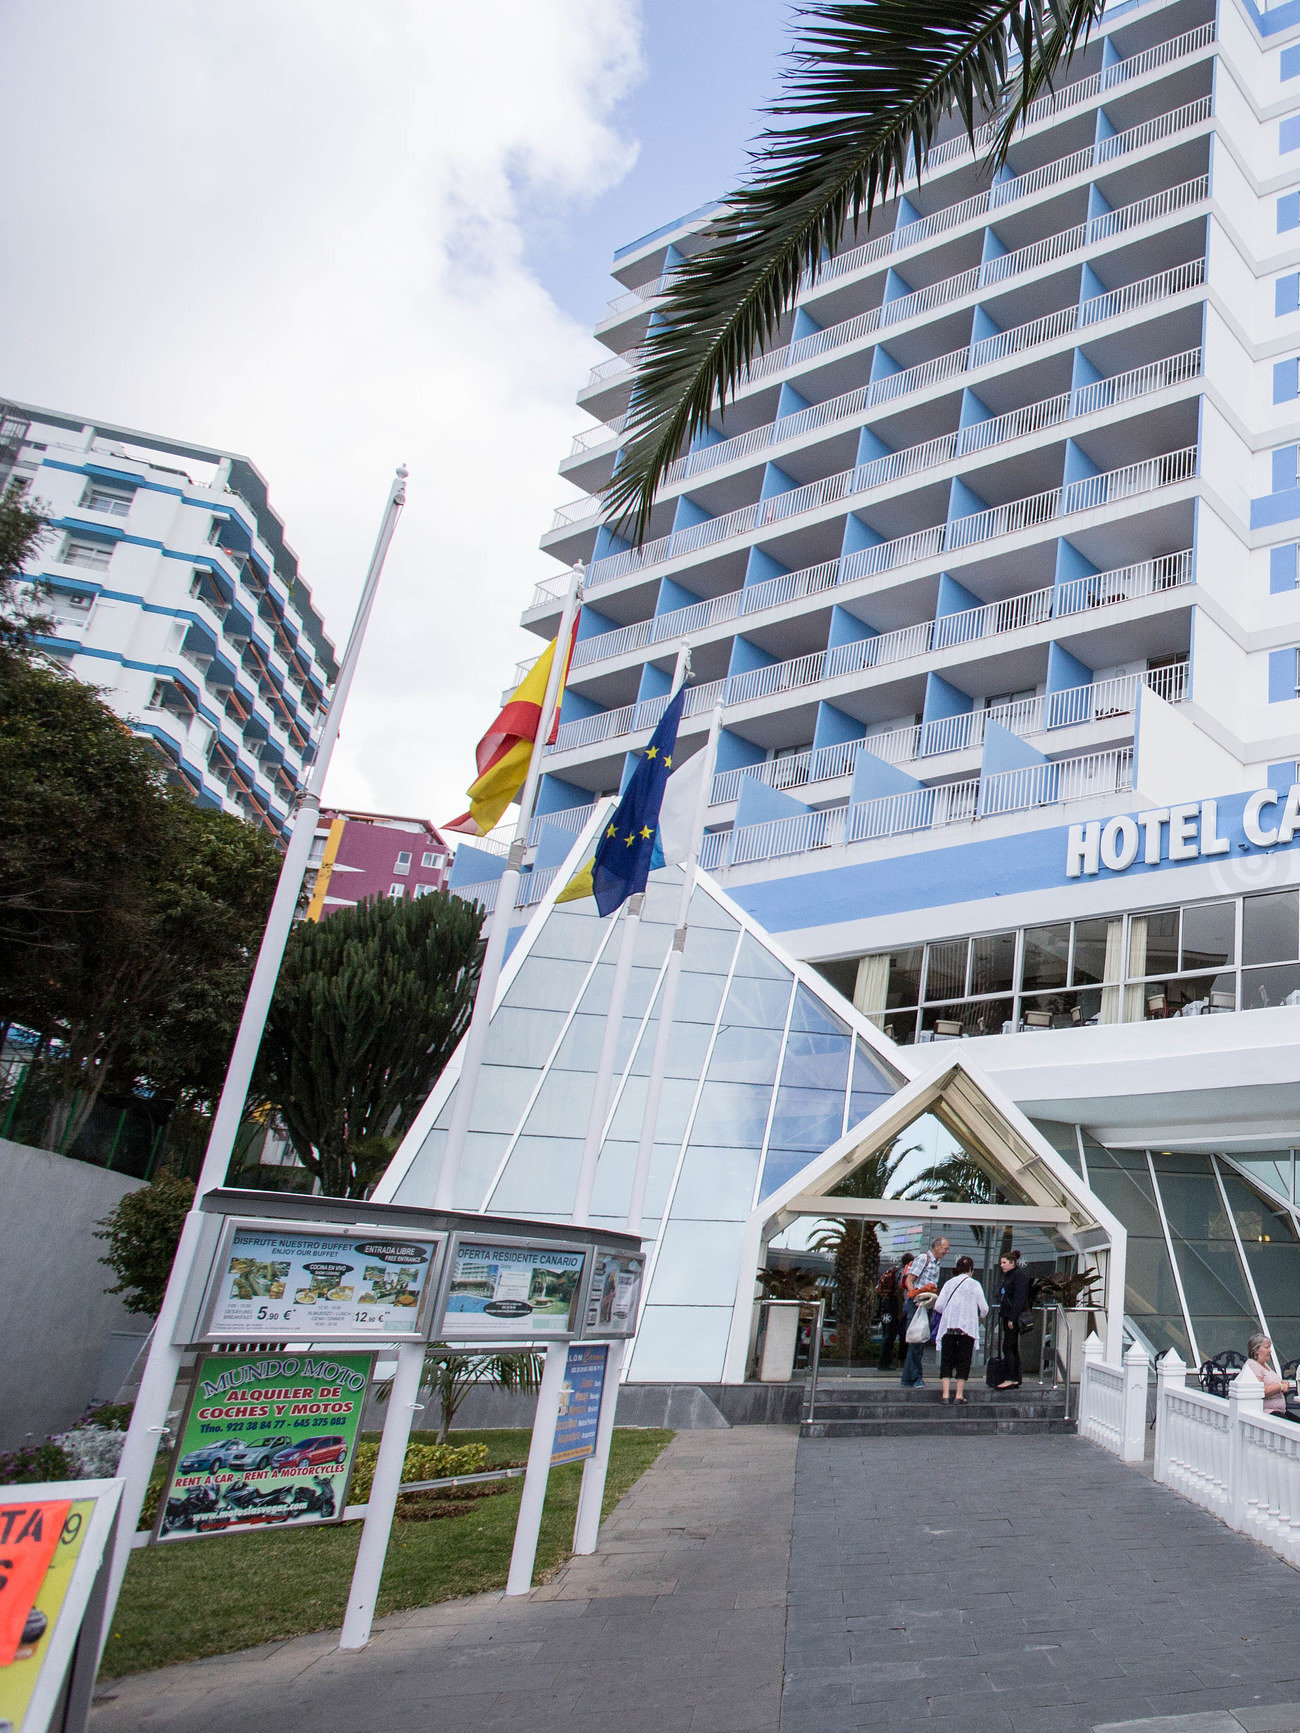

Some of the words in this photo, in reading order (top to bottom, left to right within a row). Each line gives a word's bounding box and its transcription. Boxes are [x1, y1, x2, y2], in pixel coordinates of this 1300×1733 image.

[1066, 799, 1231, 878] HOTEL
[233, 1237, 277, 1247] DISFRUTE
[279, 1239, 320, 1249] NUESTRO
[322, 1242, 354, 1251] BUFFET
[272, 1247, 296, 1255] ENJOY
[364, 1245, 395, 1255] ENTRADA
[395, 1247, 416, 1256] LIBRE
[457, 1249, 490, 1260] OFERTA
[492, 1252, 539, 1264] RESIDENTE
[539, 1255, 578, 1267] CANARIO
[201, 1358, 300, 1399] MUNDO
[303, 1359, 365, 1391] MOTO
[225, 1387, 314, 1402] ALQUILER
[318, 1386, 342, 1398] DE
[198, 1404, 269, 1420] COCHES
[274, 1404, 288, 1416] Y
[290, 1401, 353, 1415] MOTOS
[200, 1423, 223, 1433] Tfno.
[227, 1422, 244, 1431] 922
[246, 1421, 259, 1430] 38
[259, 1420, 271, 1429] 84
[272, 1420, 286, 1429] 77
[293, 1418, 311, 1428] 645
[312, 1418, 329, 1427] 375
[330, 1417, 346, 1426] 083
[174, 1476, 202, 1488] RENT
[203, 1476, 213, 1485] A
[214, 1474, 234, 1484] CAR
[243, 1471, 270, 1482] RENT
[271, 1469, 280, 1479] A
[280, 1464, 345, 1478] MOTORCYCLES
[192, 1501, 309, 1522] www.motoslasvegas.com
